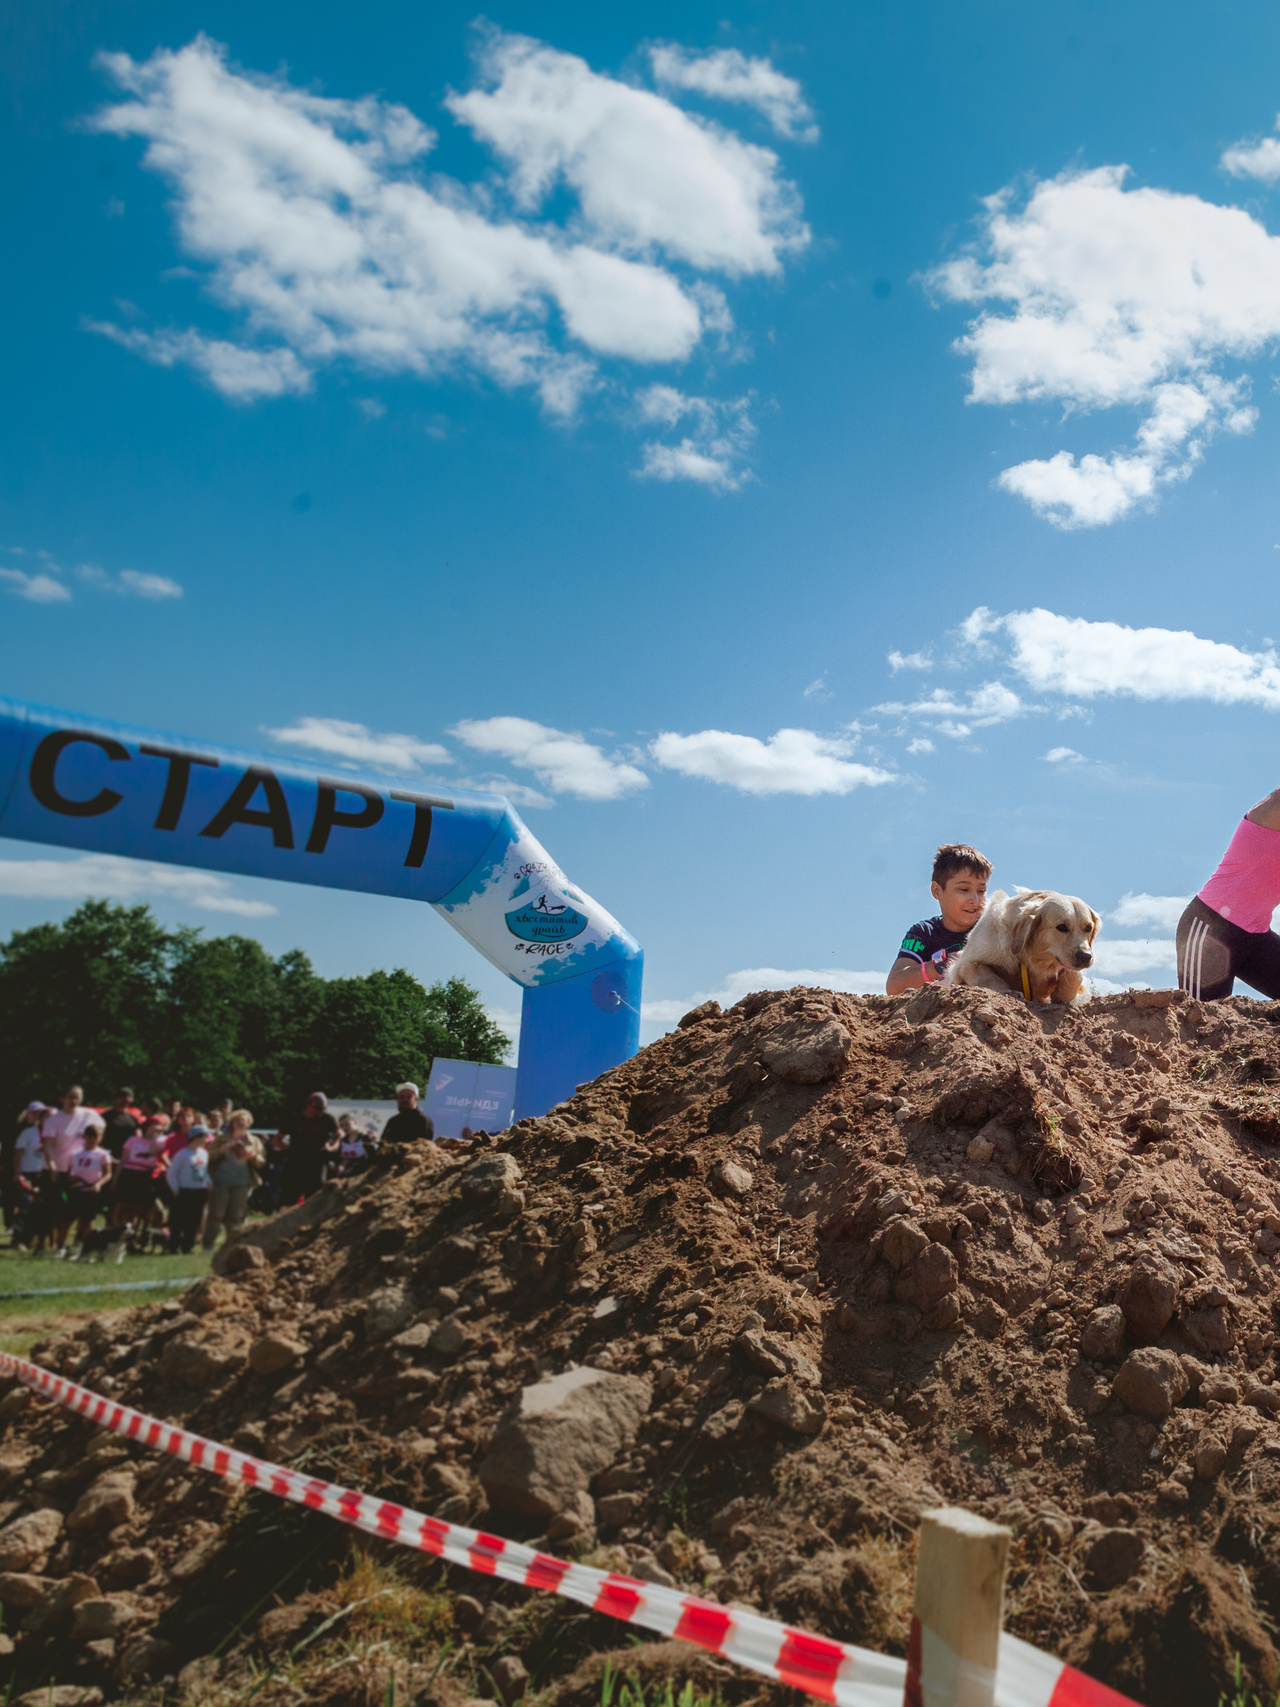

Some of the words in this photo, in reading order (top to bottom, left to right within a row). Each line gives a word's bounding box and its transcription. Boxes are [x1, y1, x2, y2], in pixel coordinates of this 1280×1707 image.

[29, 728, 455, 868] СТАРТ
[520, 862, 548, 877] CRAZY
[531, 925, 566, 938] драйв
[525, 943, 565, 956] RACE
